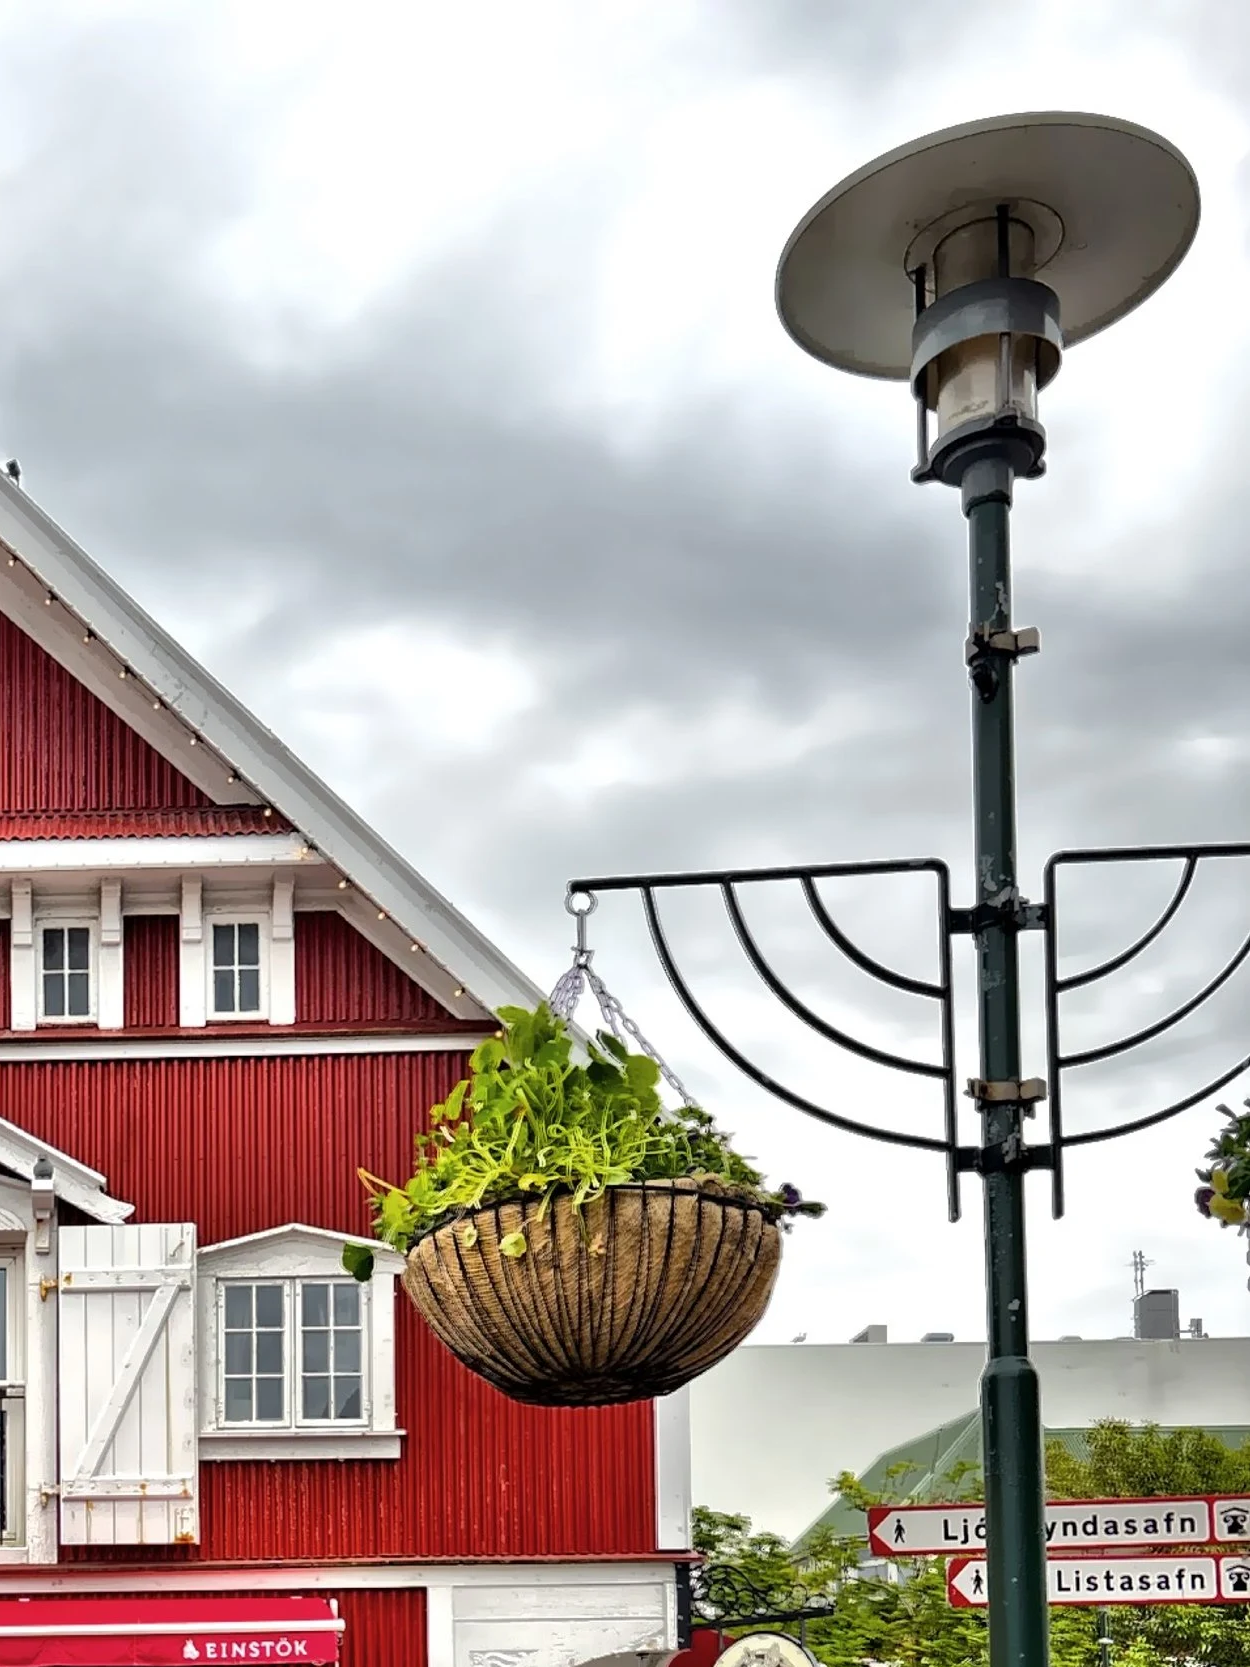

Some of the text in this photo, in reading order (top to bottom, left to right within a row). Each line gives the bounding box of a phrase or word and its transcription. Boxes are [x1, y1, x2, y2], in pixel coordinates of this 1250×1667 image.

[943, 1512, 1196, 1544] Ljóyndasafn
[1056, 1568, 1206, 1593] Listasafn
[205, 1637, 308, 1658] EINSTÖK
